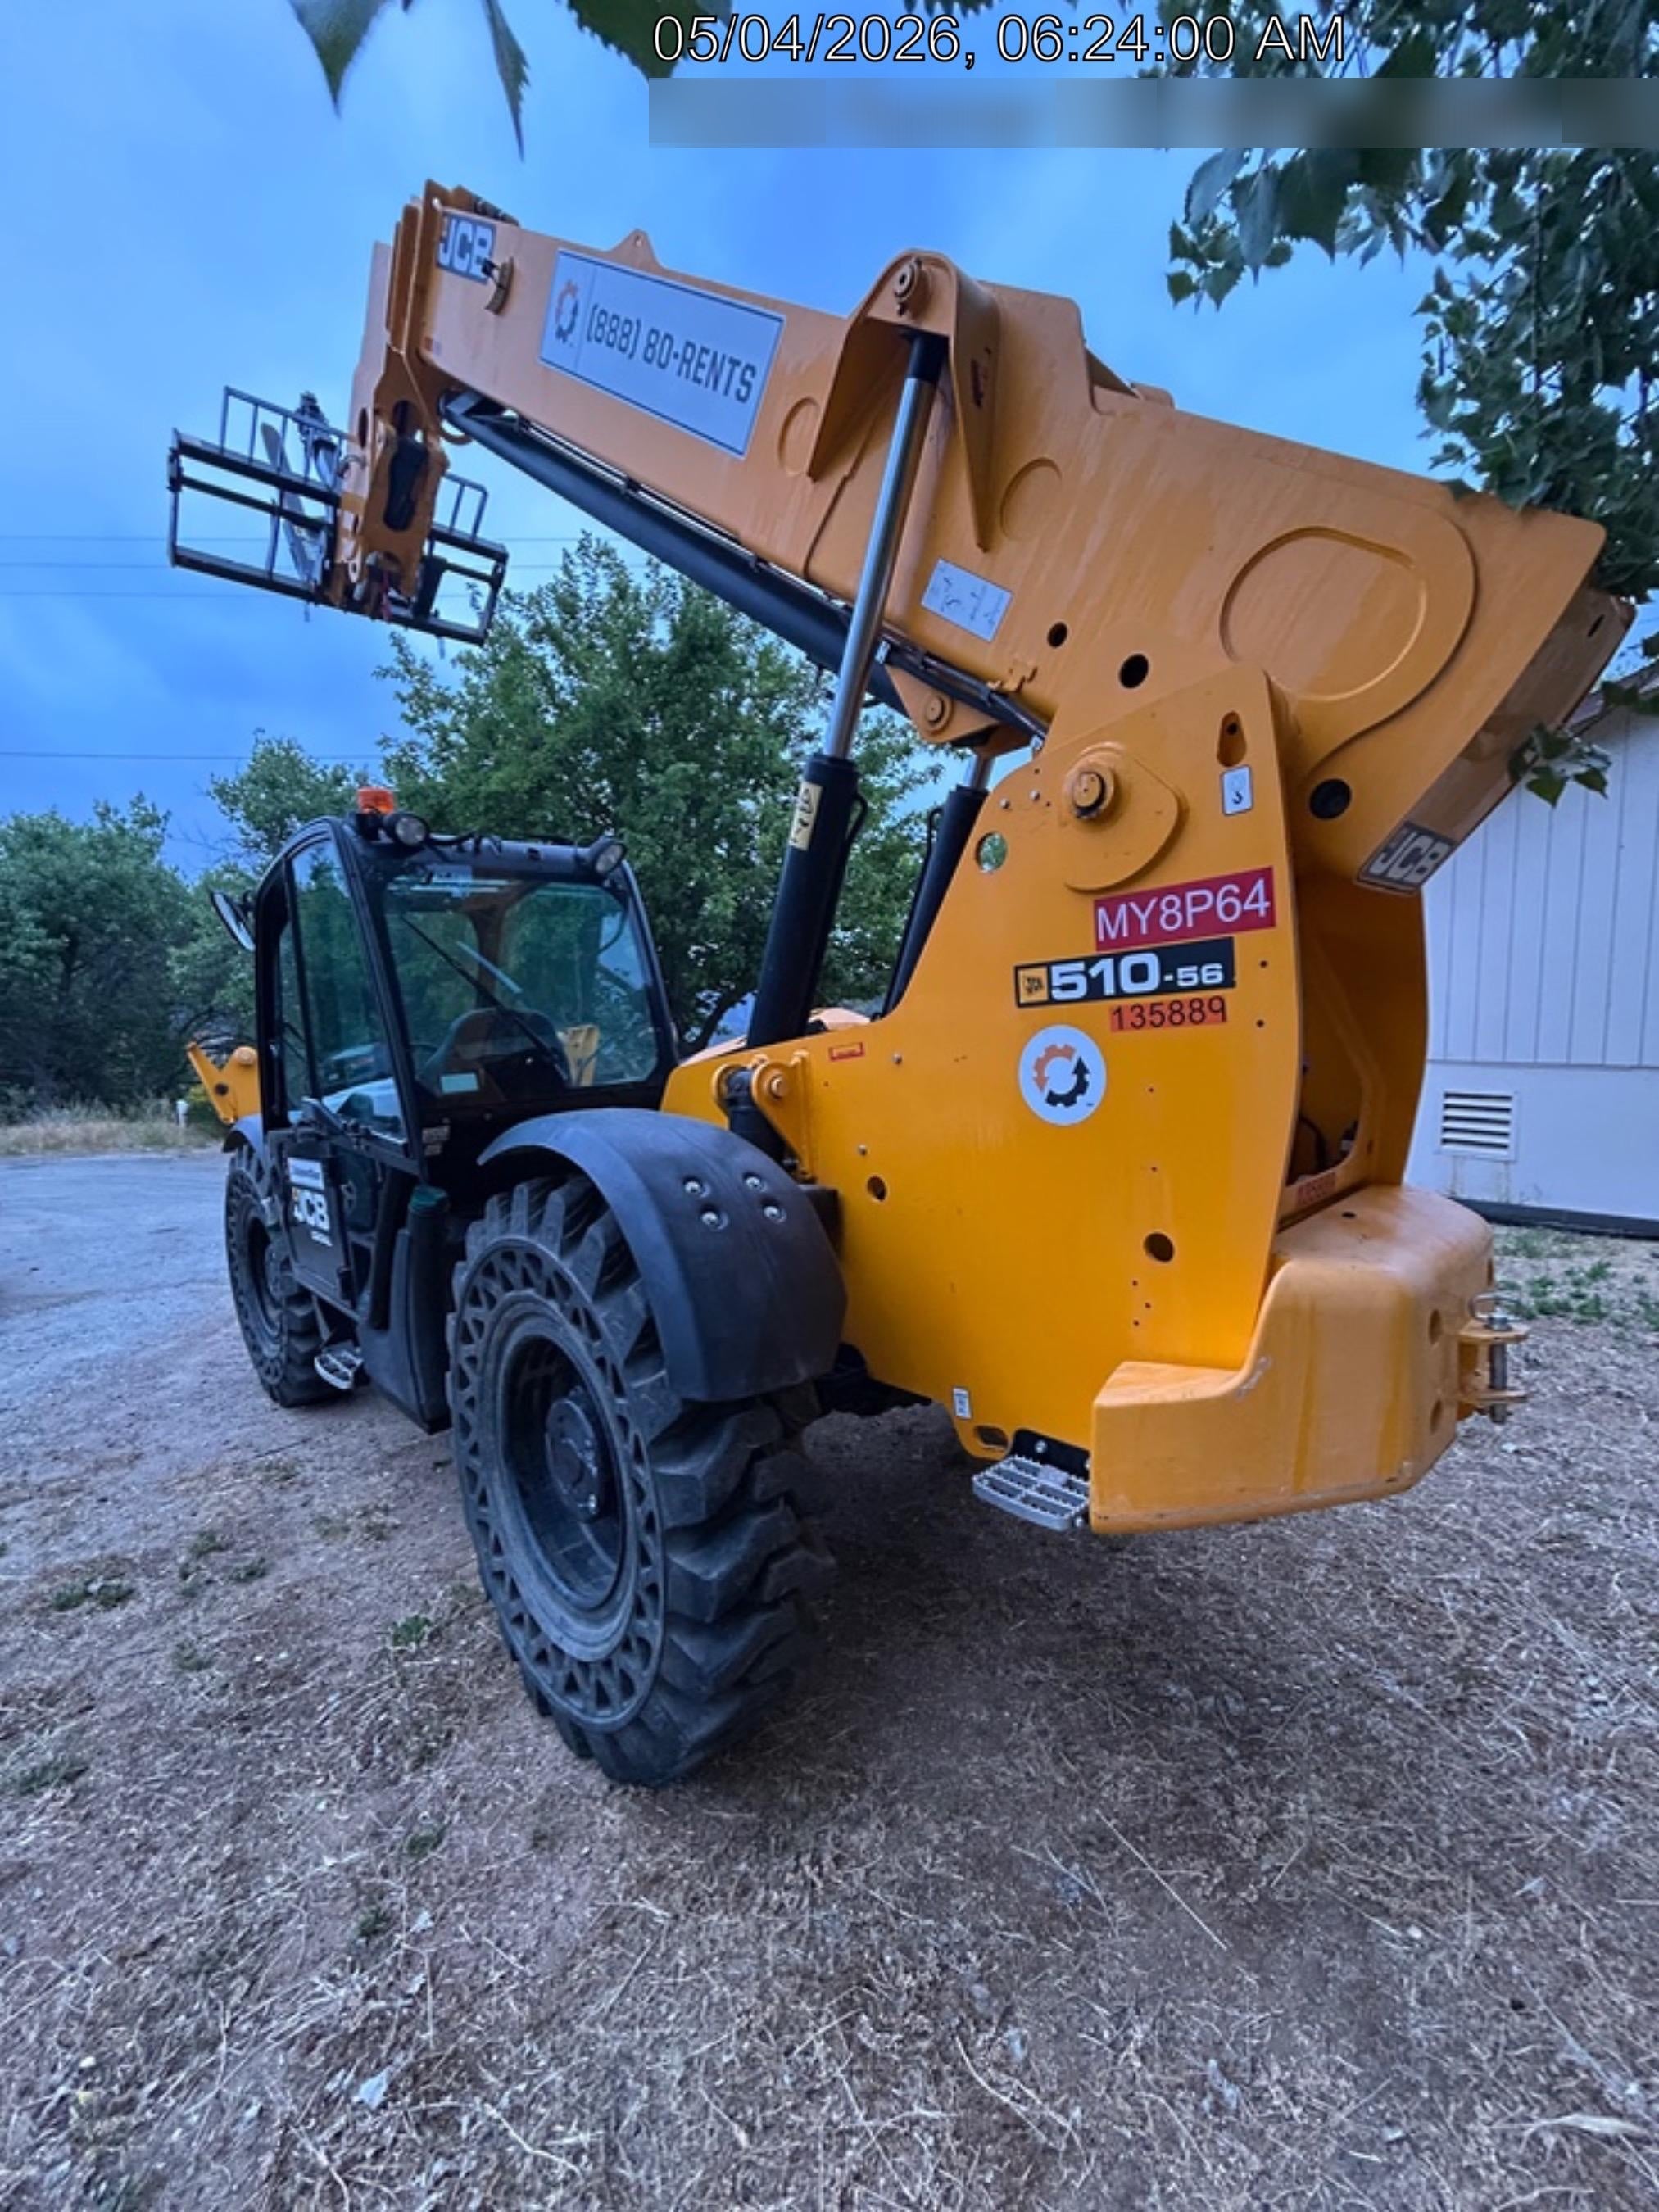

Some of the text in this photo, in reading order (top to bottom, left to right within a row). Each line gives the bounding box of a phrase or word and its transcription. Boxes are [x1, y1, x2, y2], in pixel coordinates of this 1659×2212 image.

[437, 213, 492, 283] JCB
[586, 302, 758, 405] (888) 80-RENTS
[1368, 831, 1452, 884] JCB
[1097, 878, 1270, 942] MY8P64
[1050, 952, 1224, 1001] 510-56
[1111, 995, 1227, 1031] 135889
